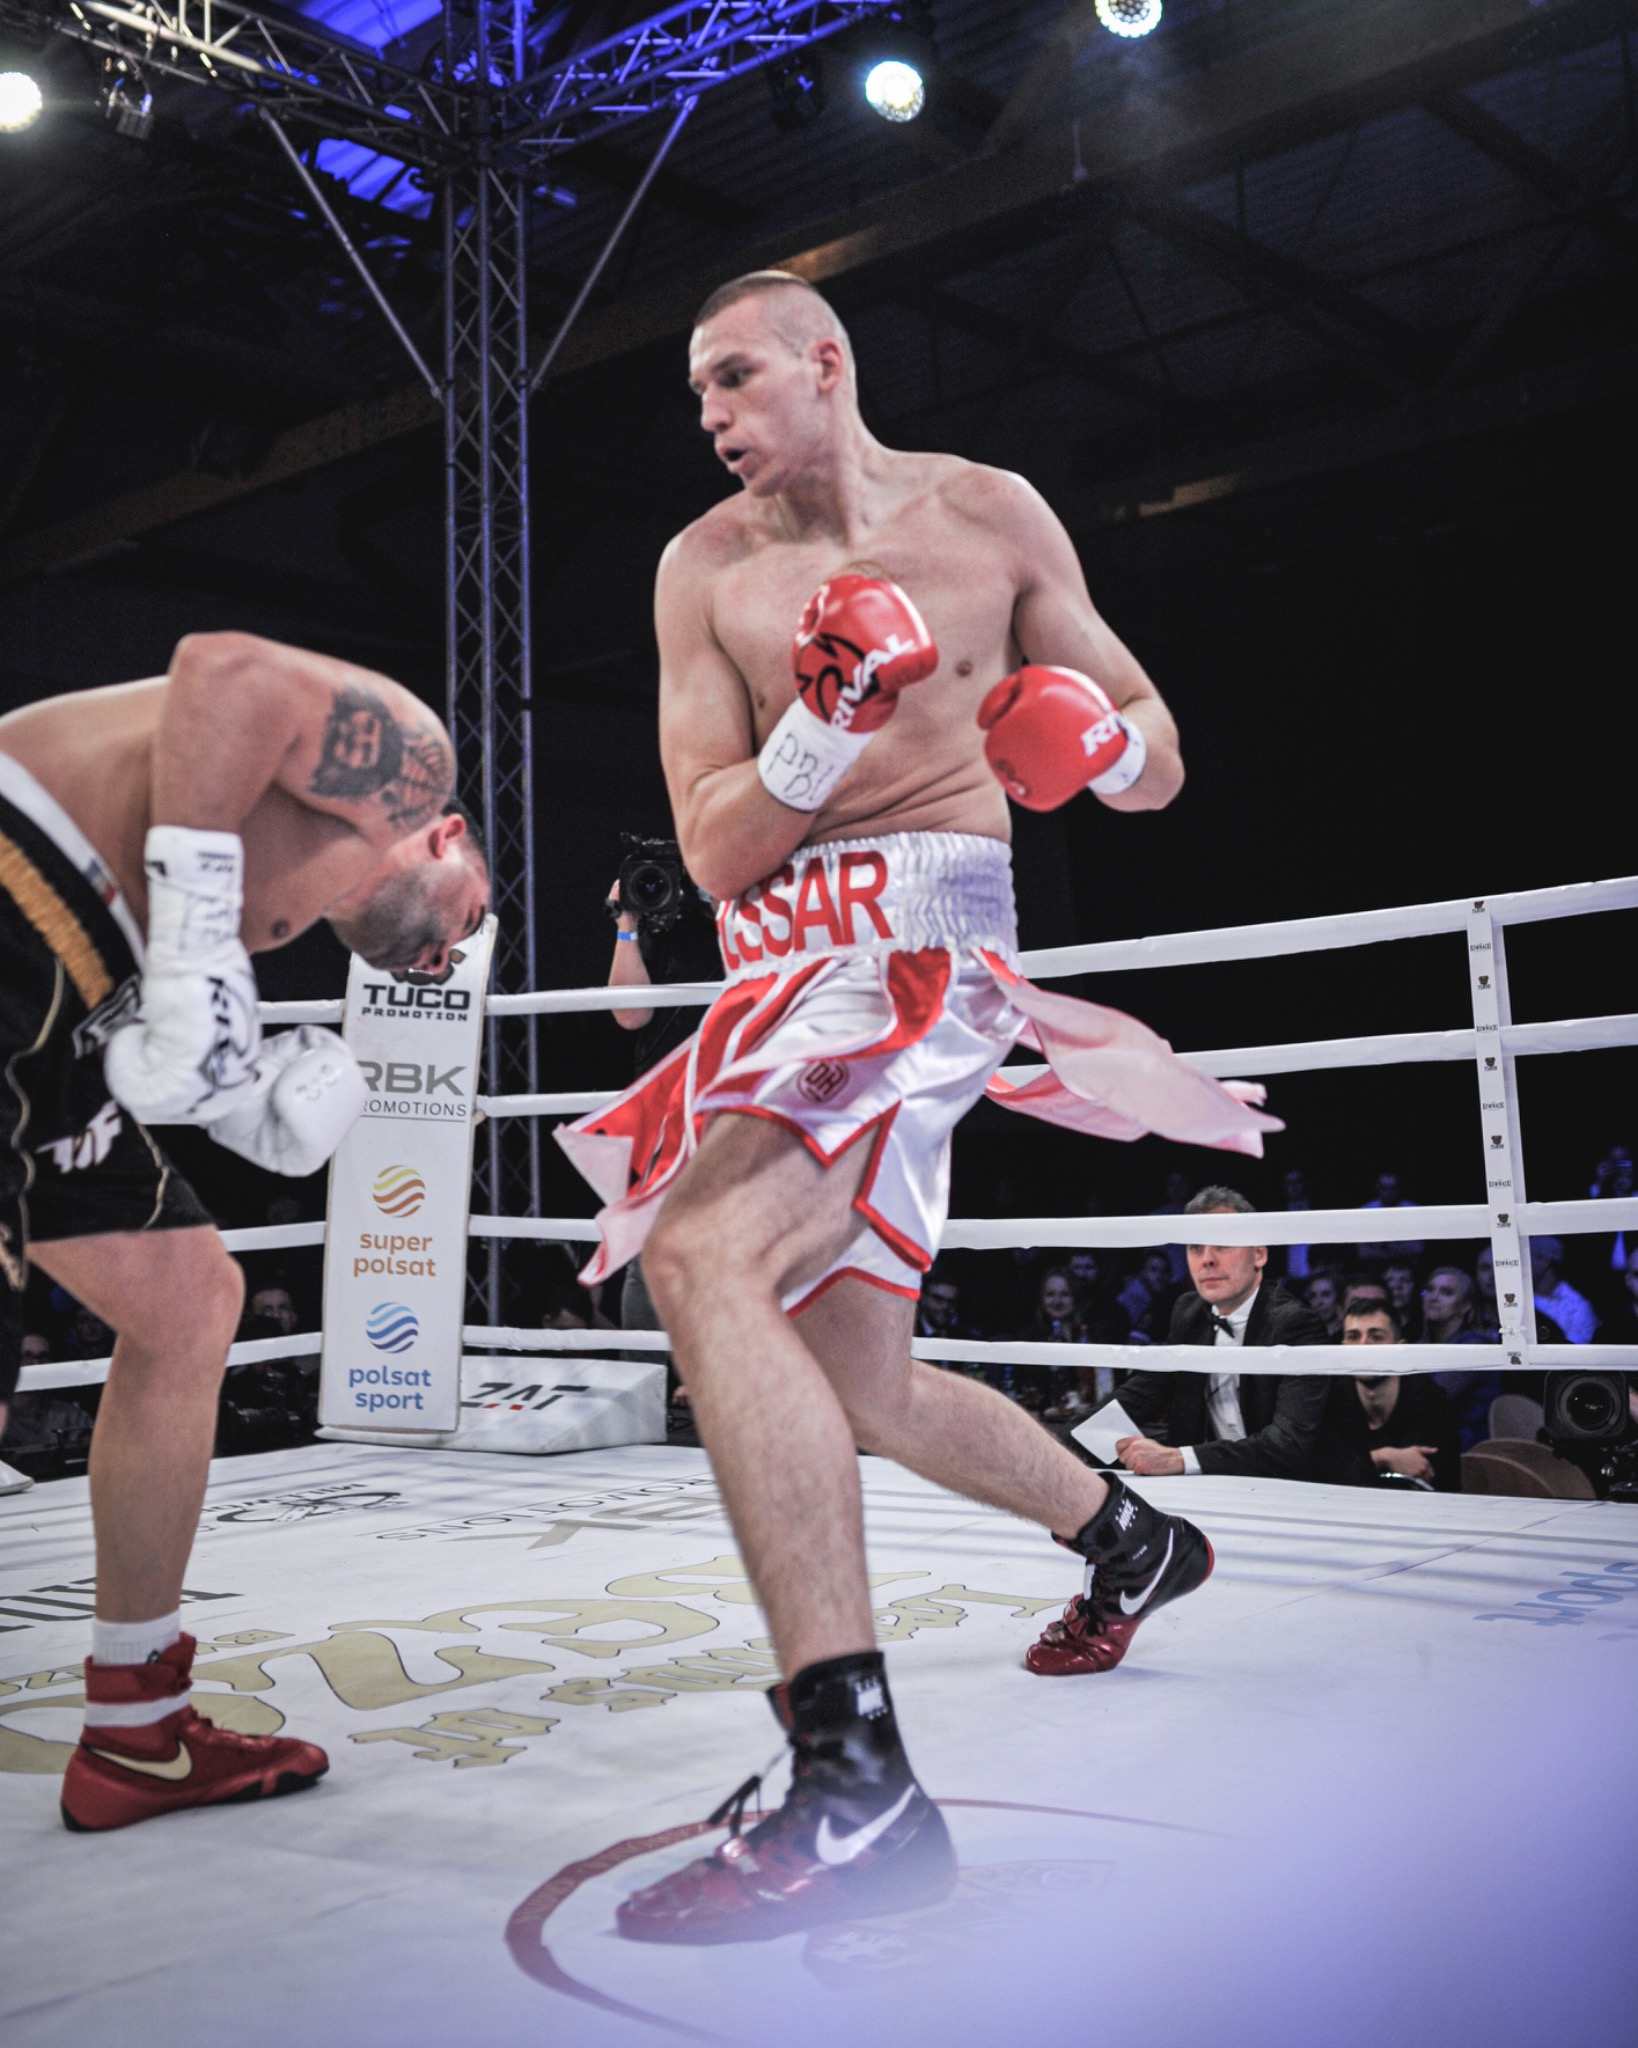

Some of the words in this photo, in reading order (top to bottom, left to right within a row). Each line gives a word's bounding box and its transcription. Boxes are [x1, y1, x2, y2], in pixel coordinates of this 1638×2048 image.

[829, 633, 914, 732] RIVAL
[362, 984, 471, 1011] TUCO
[361, 1006, 468, 1022] PROMOTION
[364, 1100, 467, 1117] OMOTIONS
[359, 1233, 433, 1255] super
[353, 1257, 436, 1277] polsat
[348, 1365, 432, 1388] polsat
[354, 1391, 424, 1413] sport
